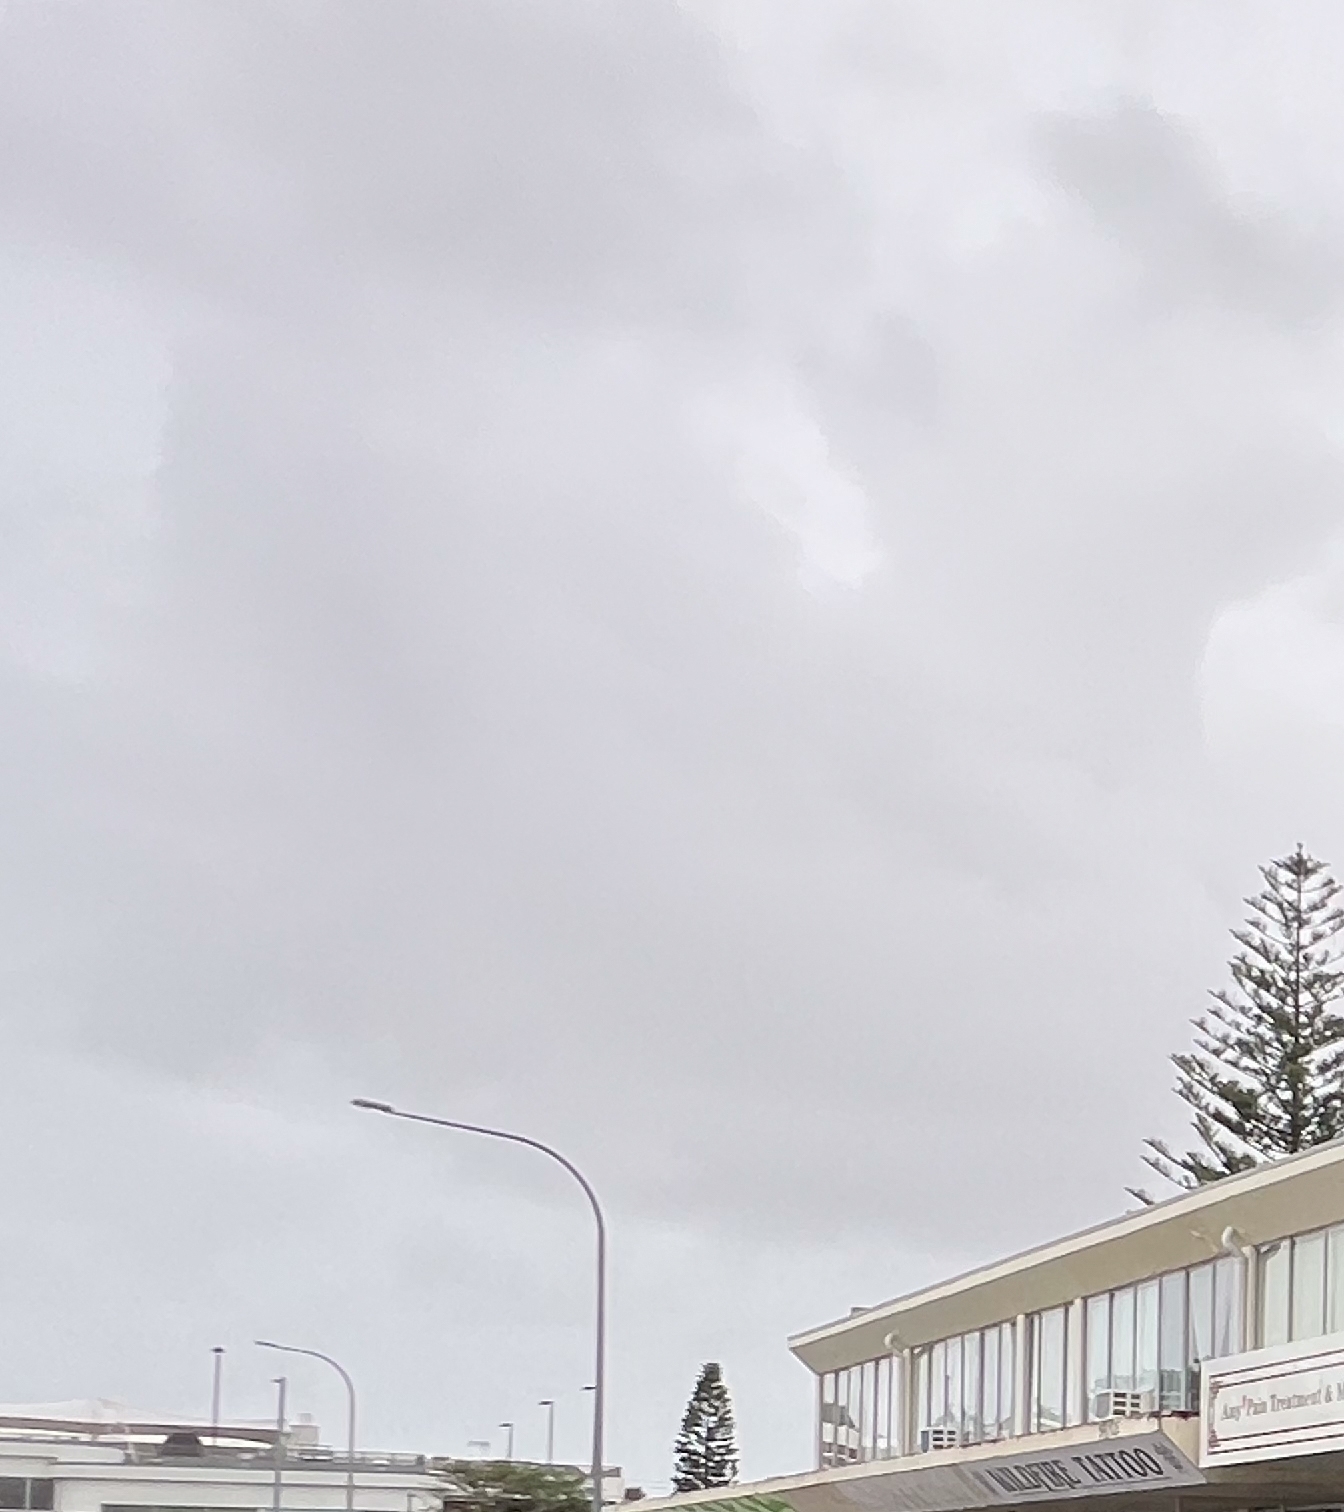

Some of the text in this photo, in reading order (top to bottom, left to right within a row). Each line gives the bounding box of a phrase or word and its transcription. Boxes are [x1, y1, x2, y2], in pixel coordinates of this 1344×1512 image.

[1270, 1388, 1321, 1412] Treatment
[1324, 1384, 1333, 1404] &
[987, 1448, 1165, 1493] WILDFIRE TATTOO
